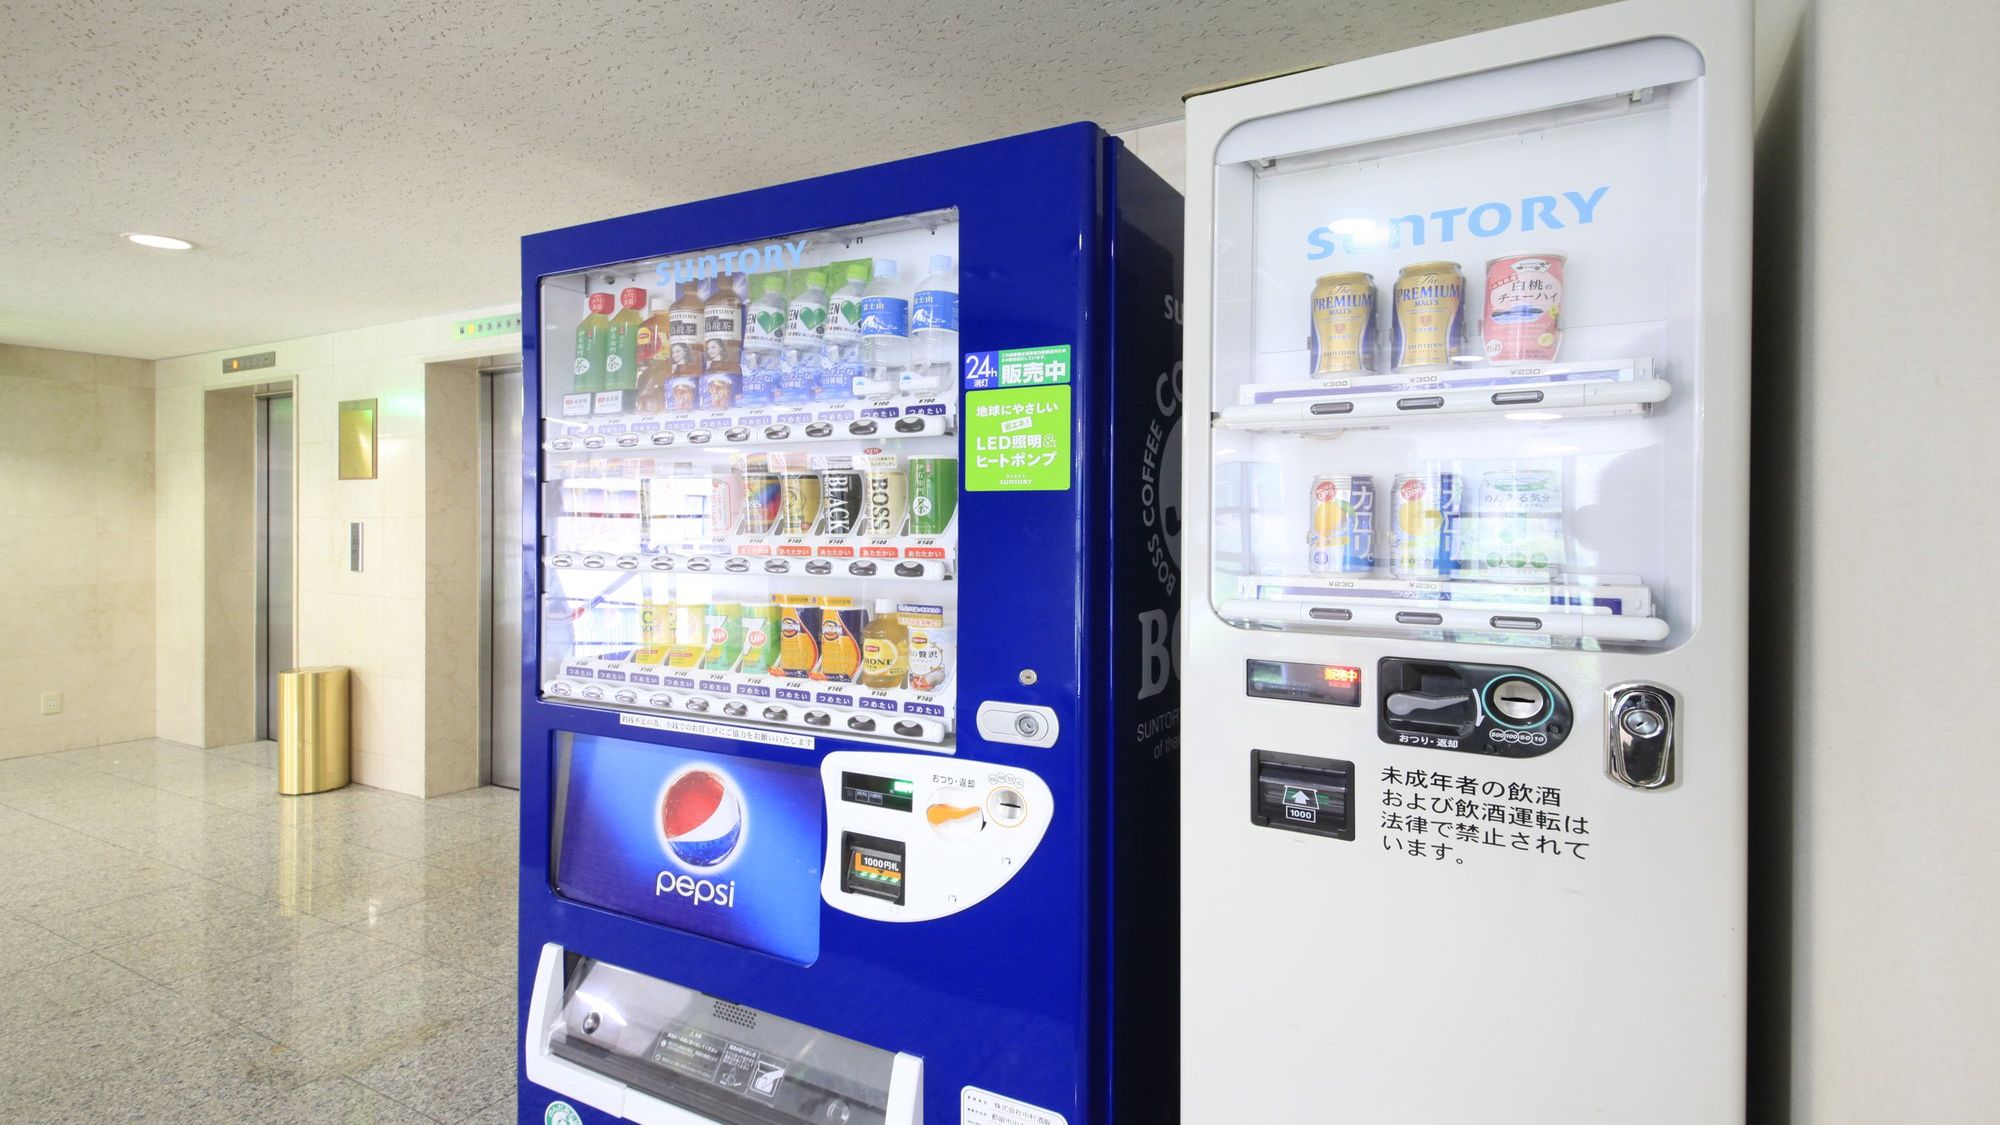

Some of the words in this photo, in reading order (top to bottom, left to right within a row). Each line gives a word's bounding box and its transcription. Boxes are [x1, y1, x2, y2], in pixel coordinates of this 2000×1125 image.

[655, 240, 807, 287] SUNTORY
[1397, 284, 1459, 303] PREMIUM
[1511, 280, 1552, 292] 白桃の
[1313, 294, 1371, 312] PREMIUM
[1498, 293, 1558, 304] チューハイ
[1001, 361, 1066, 384] 販売中
[1410, 375, 1437, 383] ¥300
[976, 402, 1058, 417] 地球にやさしい
[976, 451, 1057, 468] ヒートポンプ
[1142, 419, 1162, 527] COFFEE
[829, 475, 849, 533] BLACK
[872, 479, 890, 530] BOSS
[819, 548, 851, 556] あたたかい
[863, 549, 895, 557] あたたかい
[908, 549, 941, 558] あたたかい
[1148, 534, 1176, 596] BOSS
[667, 679, 692, 688] つめたい
[702, 681, 729, 691] つめたい
[740, 685, 768, 696] つめたい
[778, 690, 808, 700] つめたい
[819, 694, 851, 705] つめたい
[862, 700, 895, 710] つめたい
[907, 704, 941, 715] つめたい
[1381, 766, 1560, 807] 未成年者の飲酒
[1290, 809, 1312, 819] 1000
[1382, 789, 1589, 835] および飲酒運転は
[1381, 811, 1589, 860] 法律で禁止されて
[1383, 835, 1463, 864] います。
[656, 871, 735, 907] pepsi
